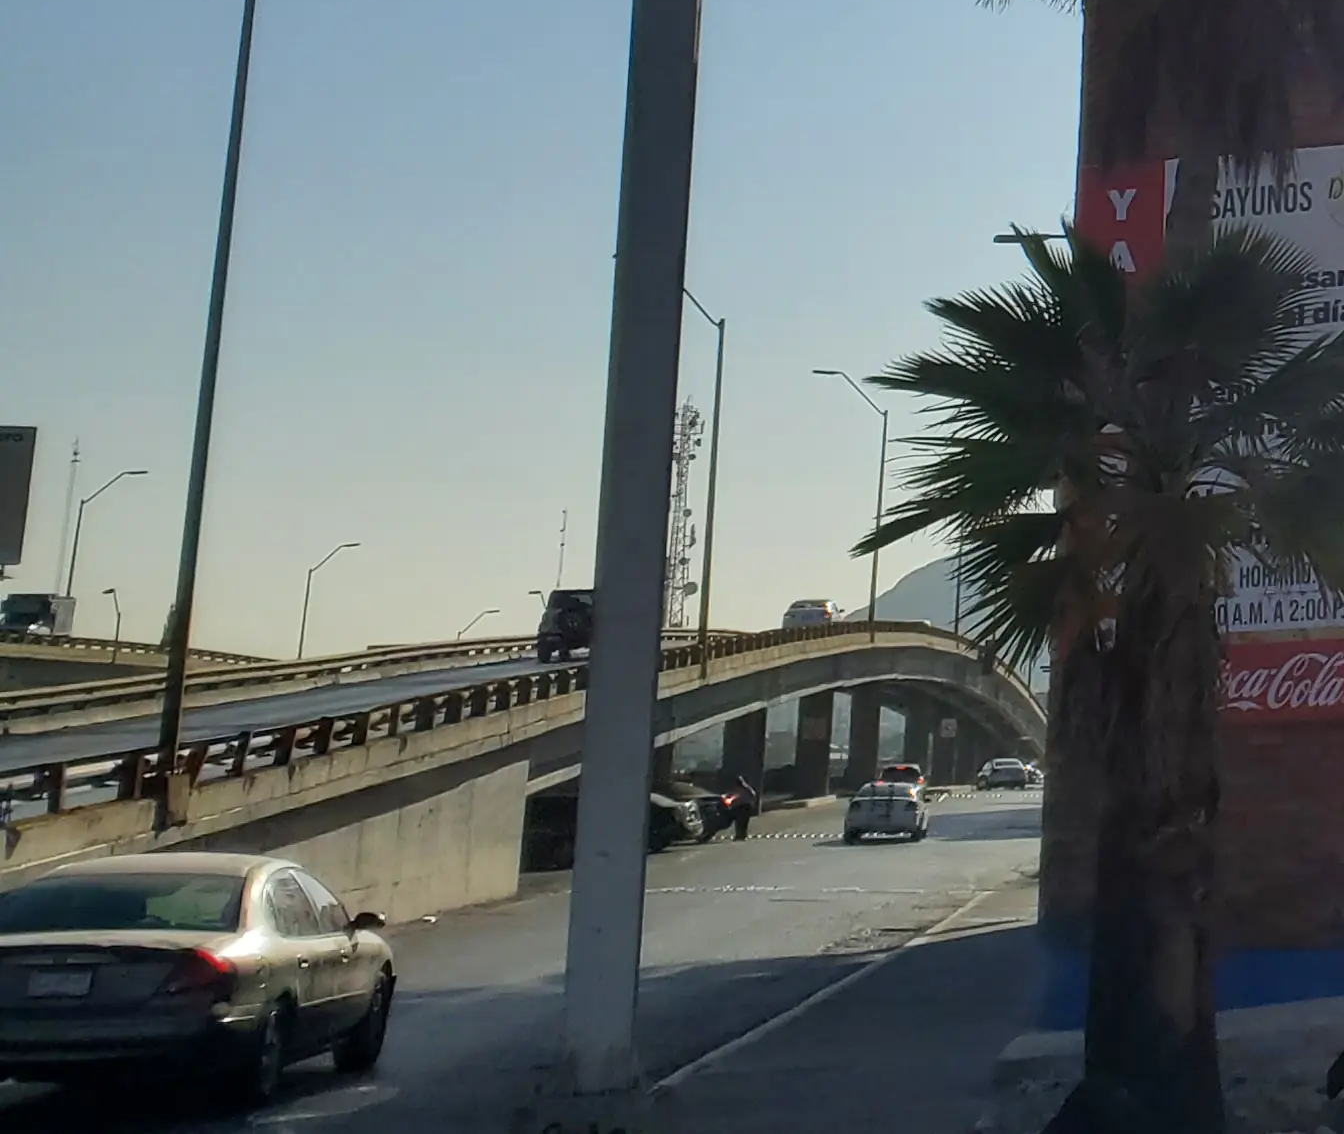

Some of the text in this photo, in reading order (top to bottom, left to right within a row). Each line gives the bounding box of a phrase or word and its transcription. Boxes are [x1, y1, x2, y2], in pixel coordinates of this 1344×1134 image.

[1232, 601, 1269, 626] A.M.
[1273, 599, 1285, 624] A
[1289, 597, 1328, 623] 2:00
